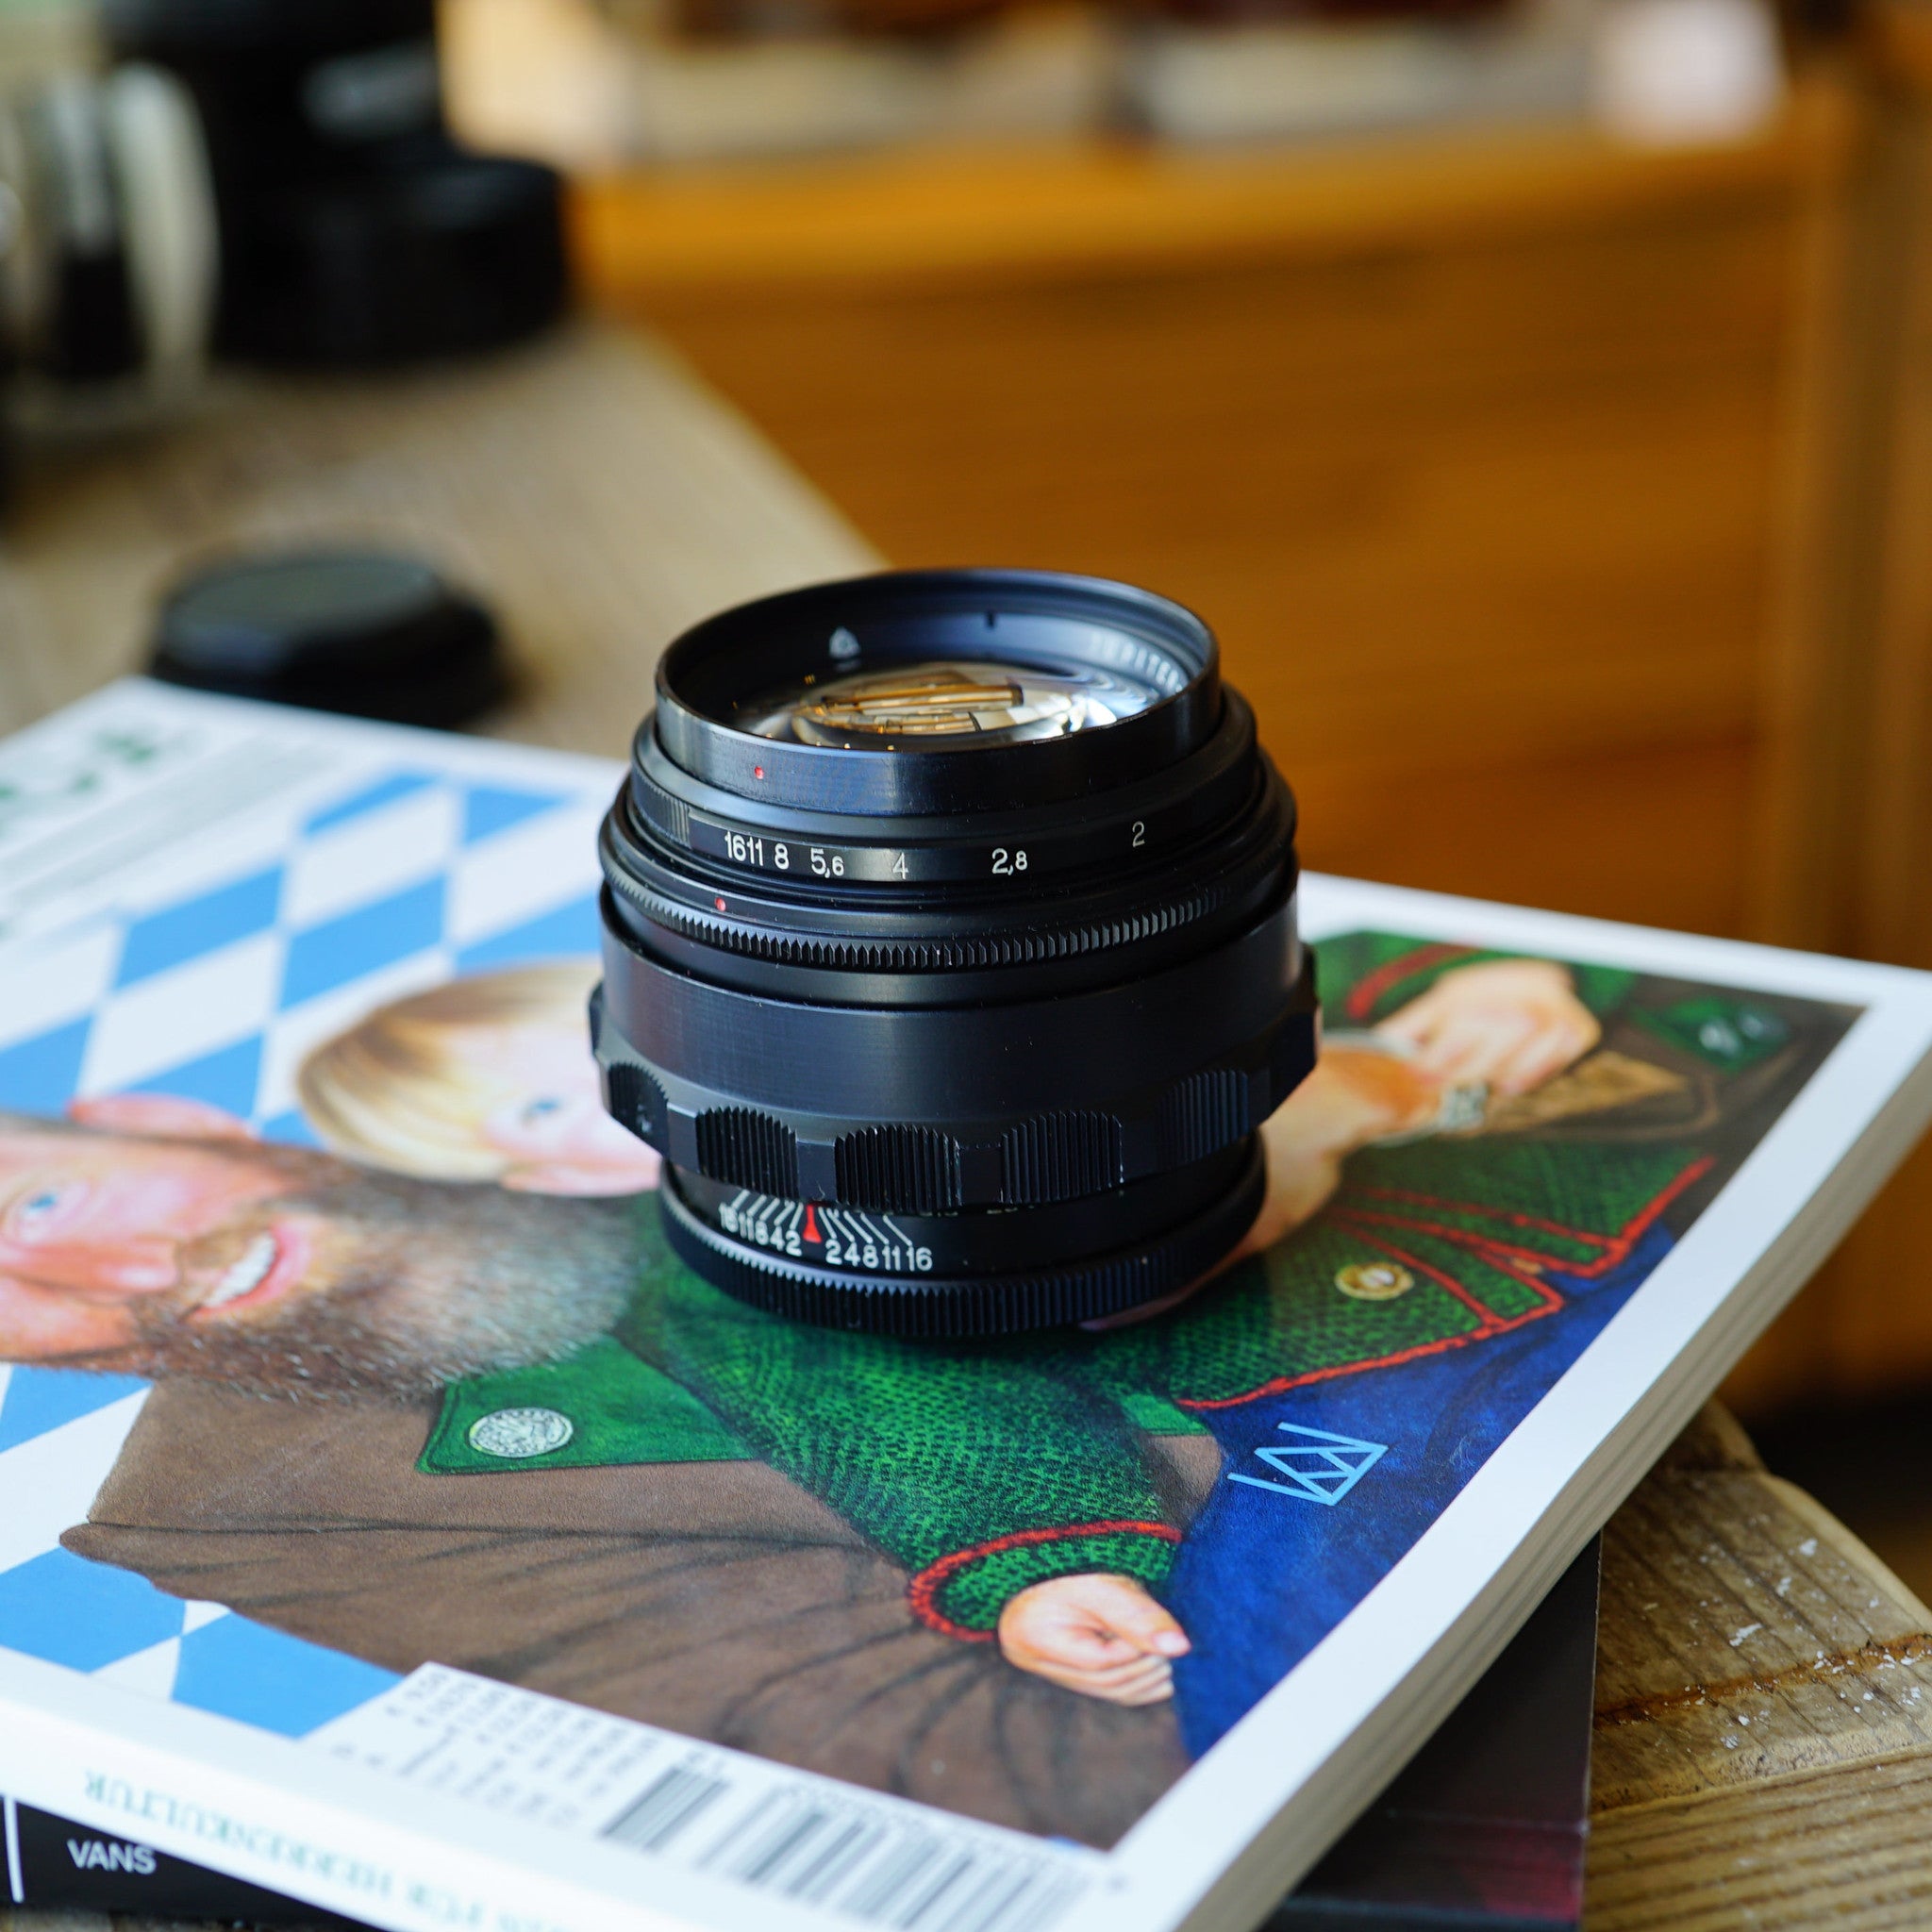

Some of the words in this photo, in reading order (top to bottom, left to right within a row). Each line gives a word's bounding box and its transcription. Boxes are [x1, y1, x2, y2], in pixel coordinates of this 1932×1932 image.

[774, 842, 790, 870] 8
[810, 847, 844, 878] 5,6
[891, 852, 909, 879] 4
[991, 848, 1028, 875] 2,8
[1132, 821, 1145, 847] 2
[66, 1839, 158, 1875] VANS
